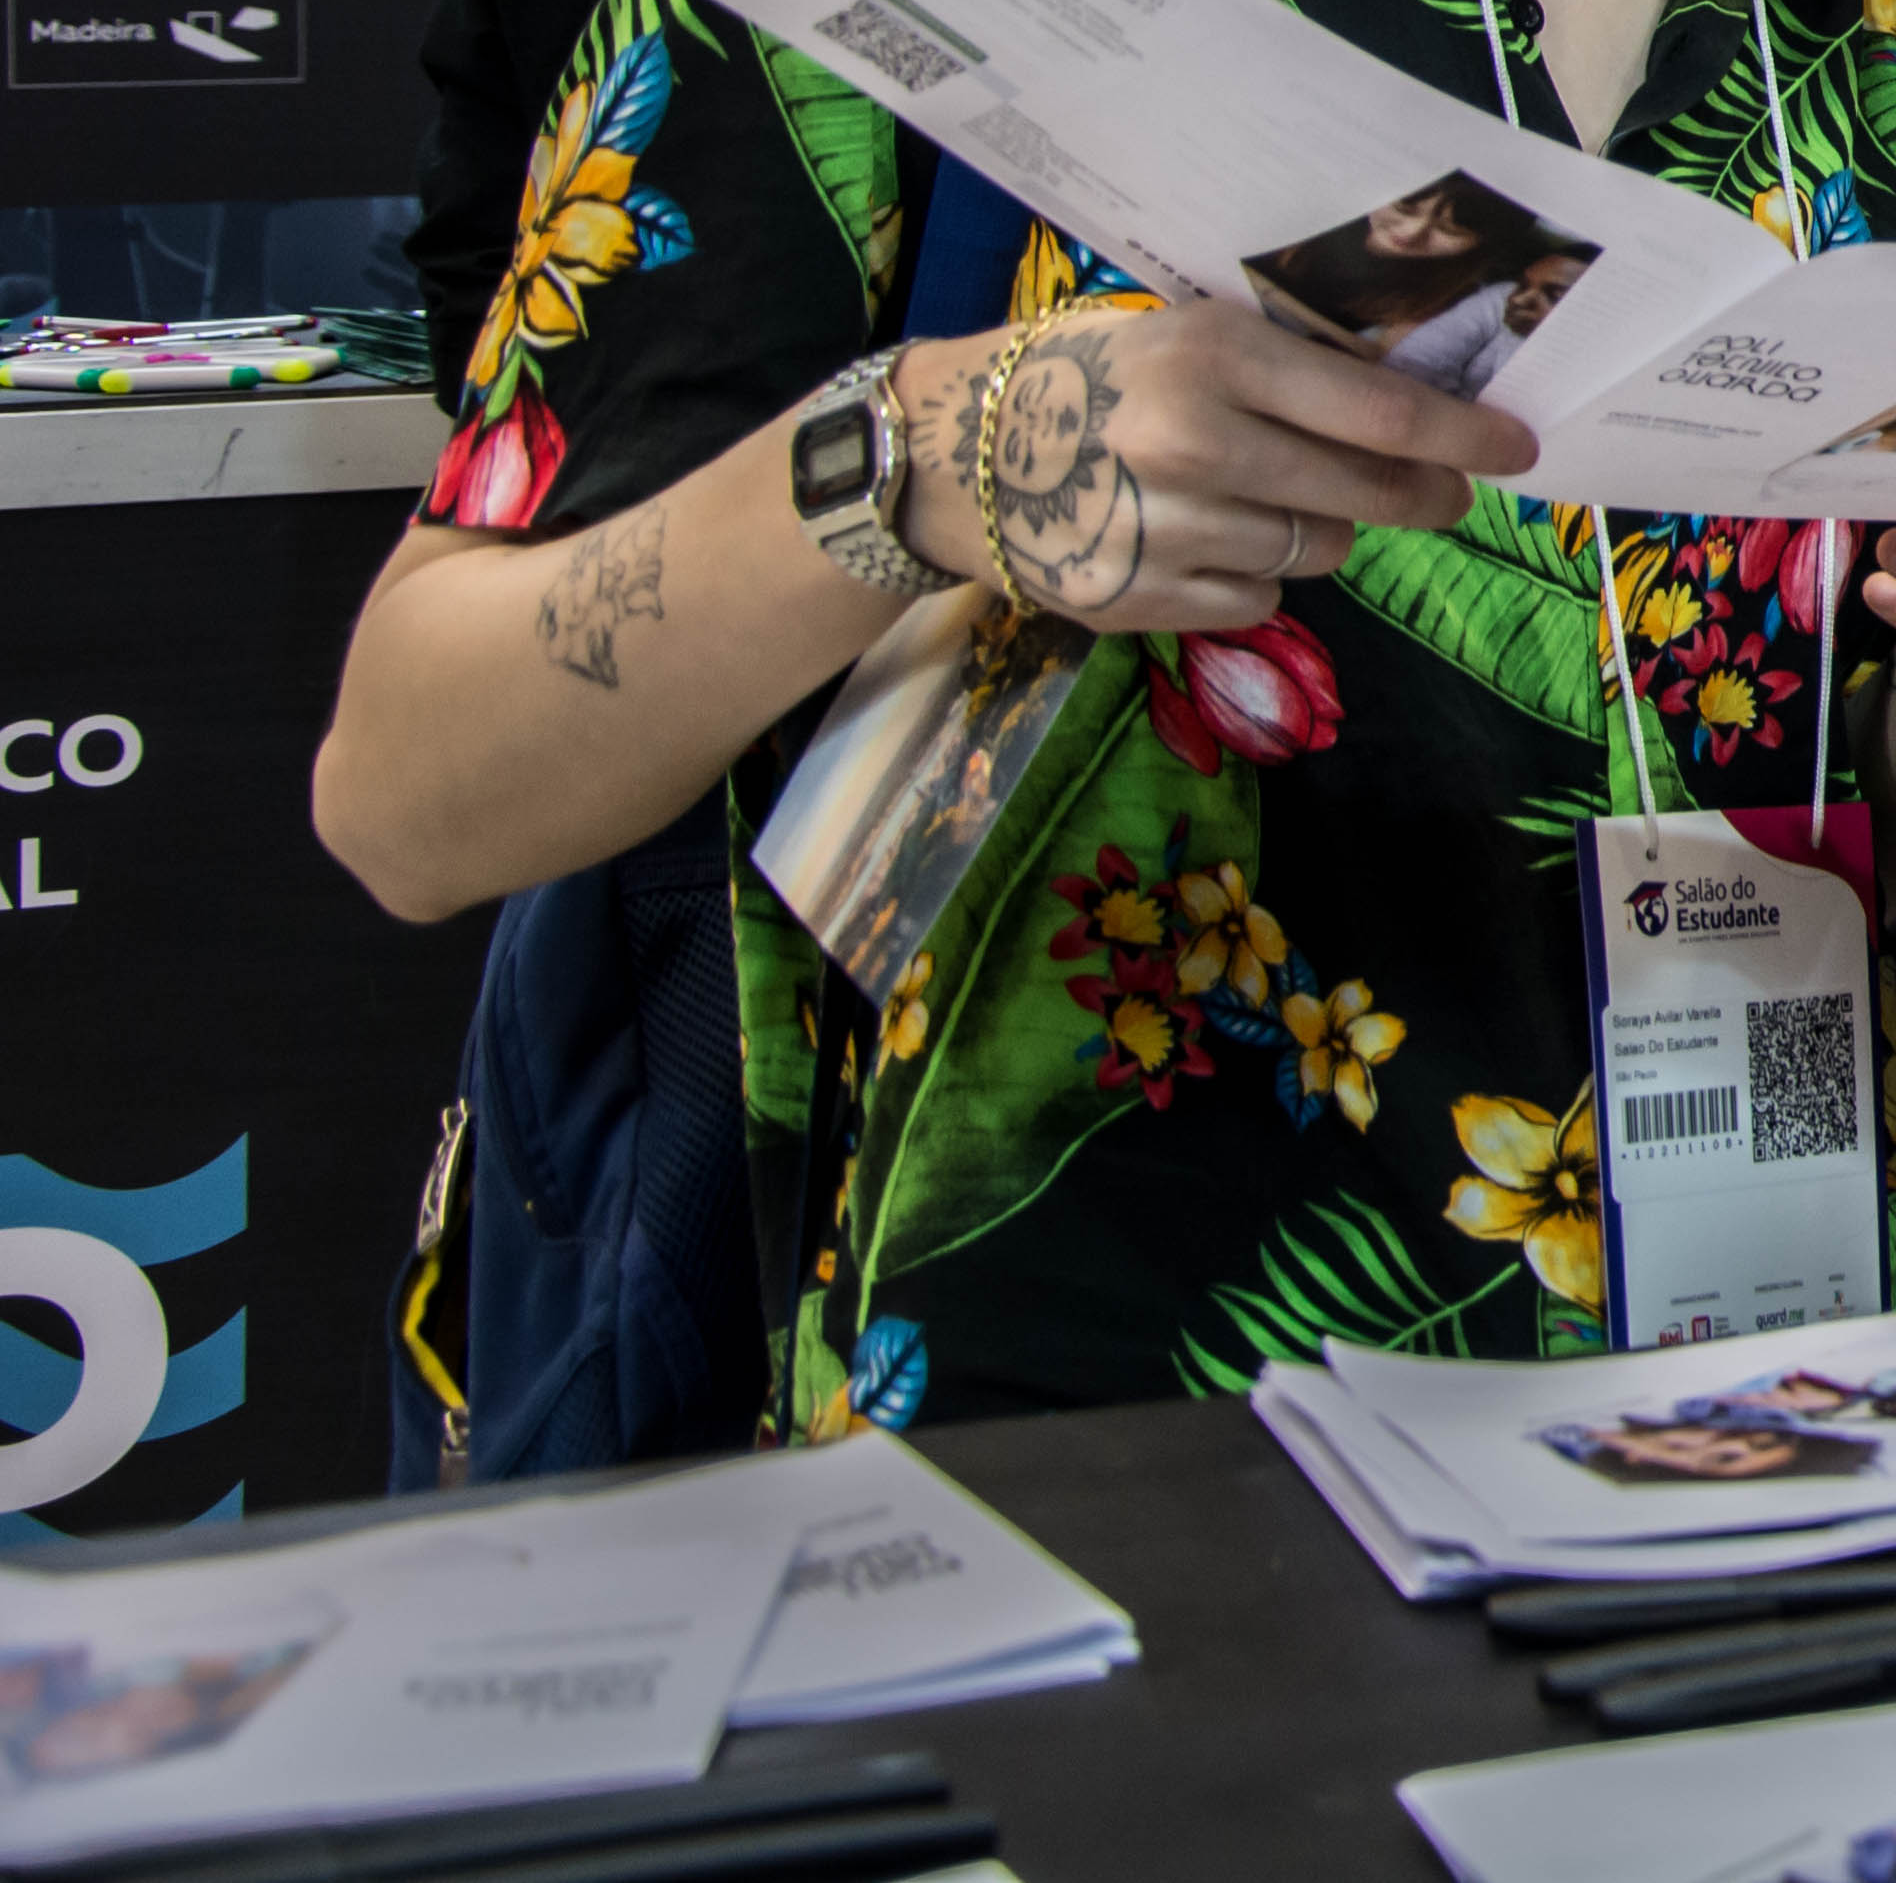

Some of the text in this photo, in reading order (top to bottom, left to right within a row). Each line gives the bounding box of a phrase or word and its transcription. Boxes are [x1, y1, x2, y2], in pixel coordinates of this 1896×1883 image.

[31, 18, 155, 45] Madeira
[1675, 874, 1756, 905] Salão do
[1676, 902, 1781, 932] Estudante
[1667, 1035, 1719, 1052] Estudante
